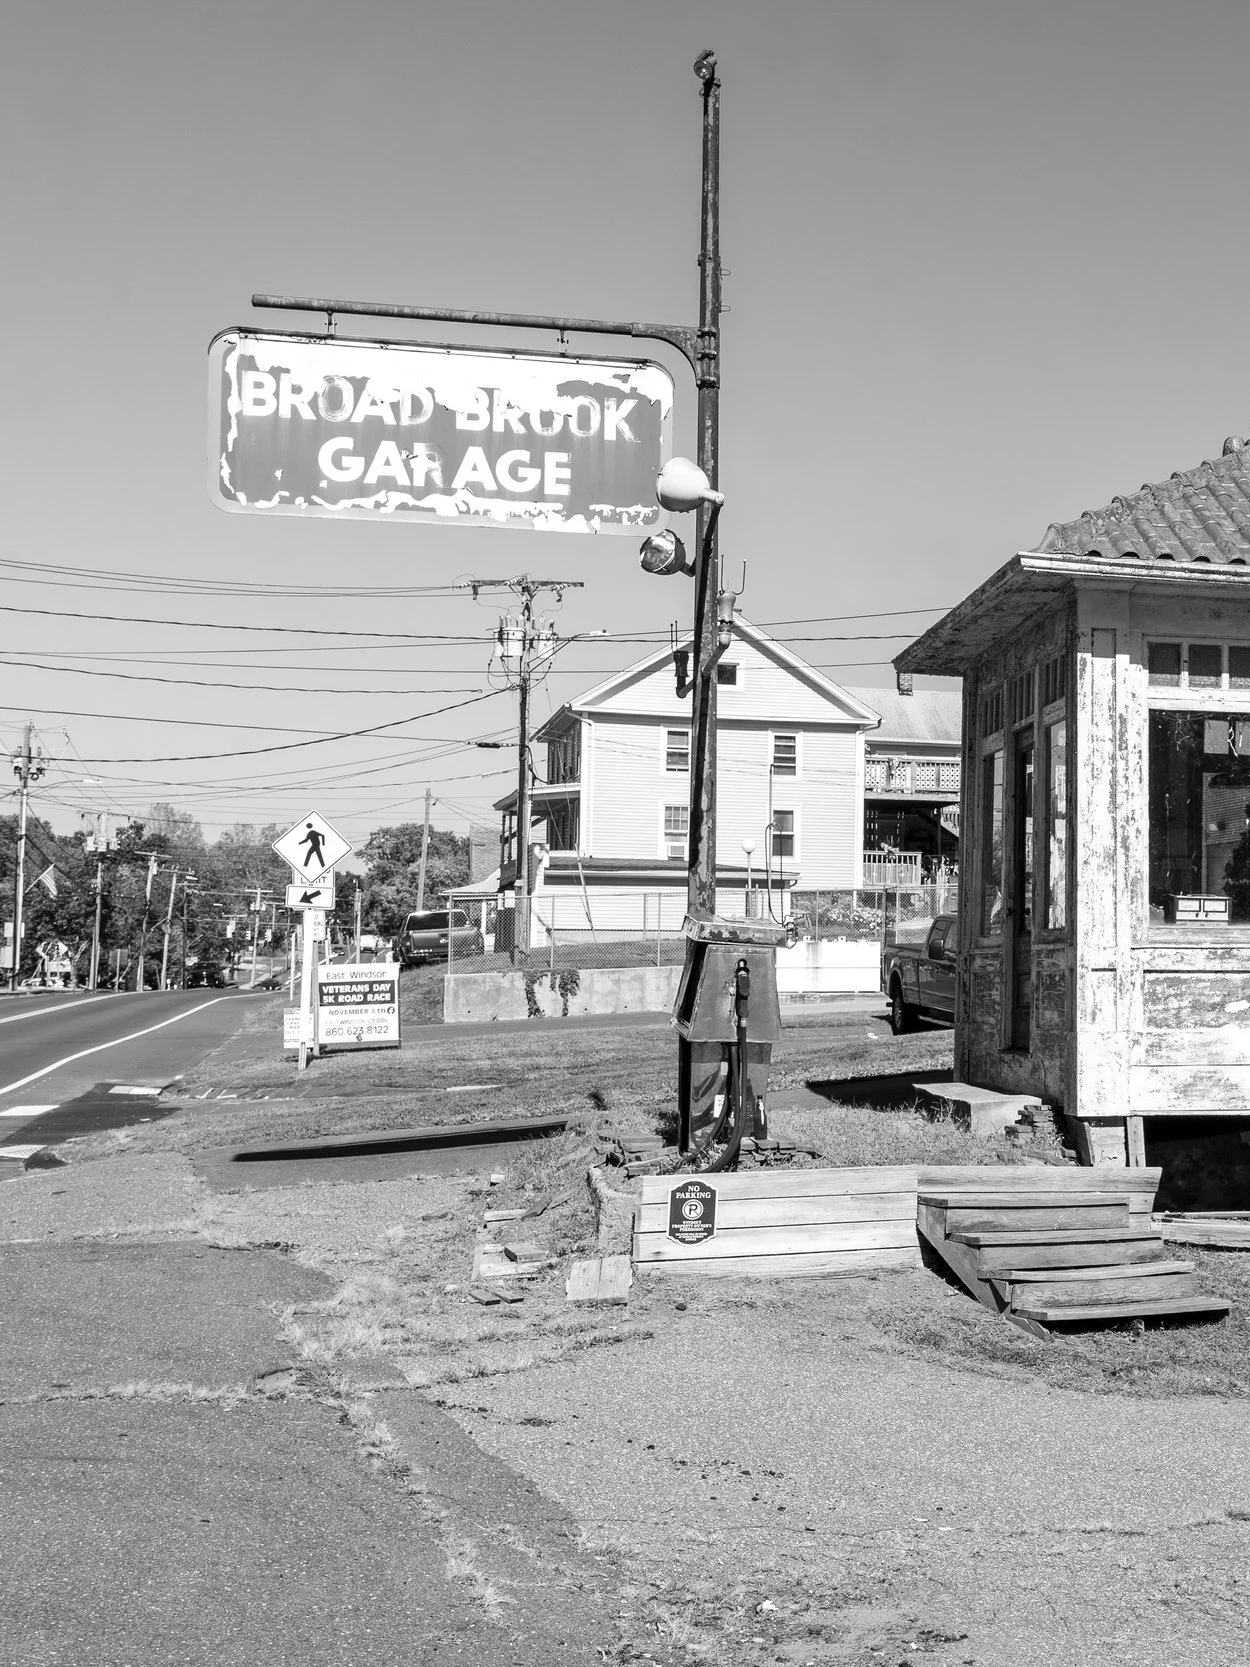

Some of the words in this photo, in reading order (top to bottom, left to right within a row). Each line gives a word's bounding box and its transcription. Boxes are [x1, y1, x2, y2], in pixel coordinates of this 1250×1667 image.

[242, 370, 434, 426] BROAD
[456, 386, 641, 443] BROOK
[318, 436, 571, 496] GARAGE
[327, 972, 345, 980] East
[350, 971, 386, 979] Windsor
[322, 984, 370, 994] VETERANS
[372, 983, 391, 991] DAY
[322, 995, 335, 1003] 5K
[338, 994, 364, 1003] ROAD
[367, 993, 391, 1002] RACE
[328, 1008, 369, 1016] NOVEMBER
[325, 1026, 389, 1037] 860.623.8122
